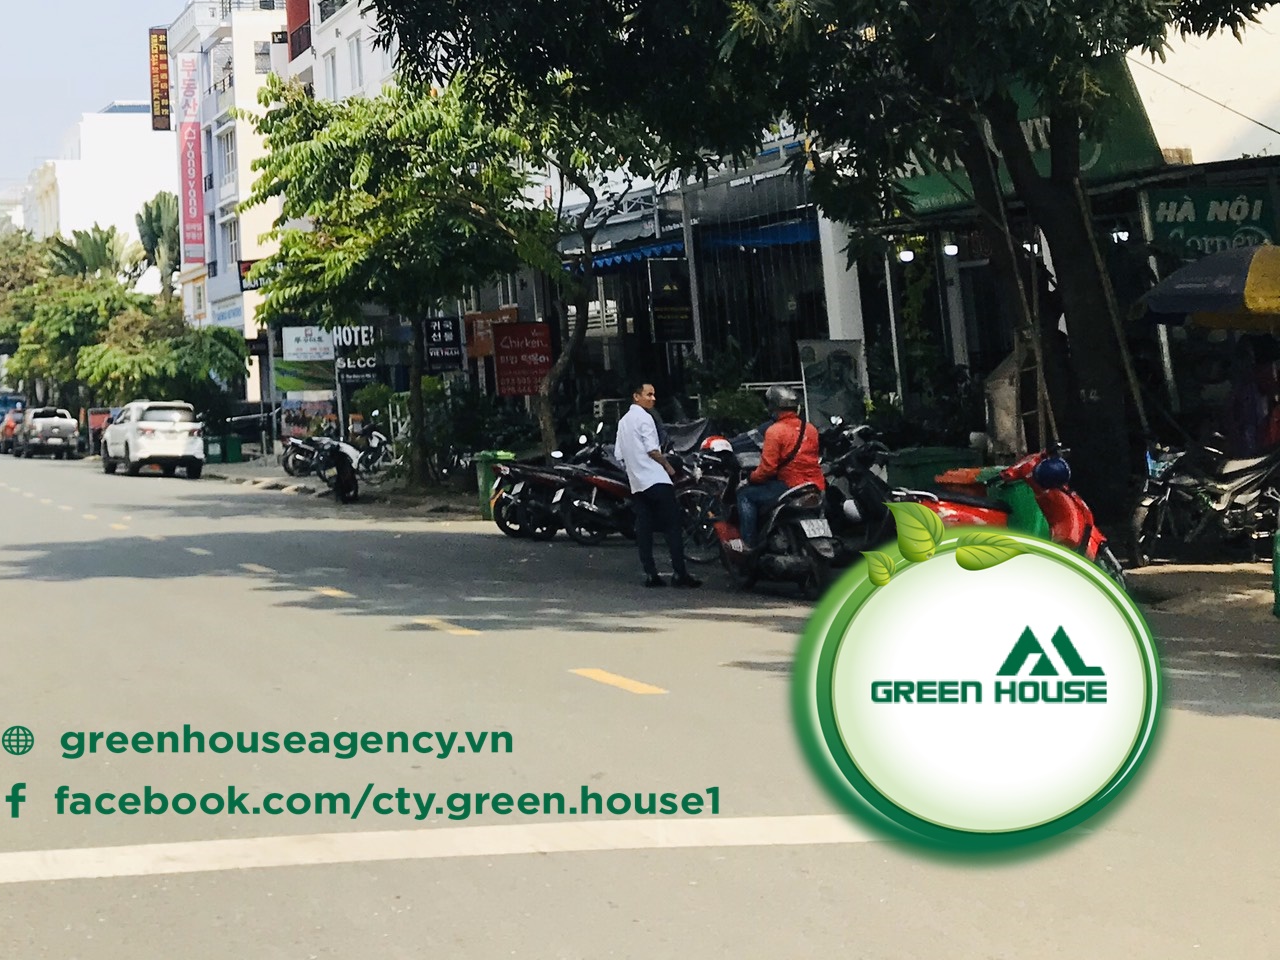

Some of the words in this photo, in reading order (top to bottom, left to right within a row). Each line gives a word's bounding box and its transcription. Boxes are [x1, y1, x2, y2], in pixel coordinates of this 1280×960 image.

[181, 59, 198, 117] 부동산
[1156, 194, 1196, 223] HÀ
[1206, 194, 1263, 225] NỘI
[429, 349, 460, 358] VIETNAM
